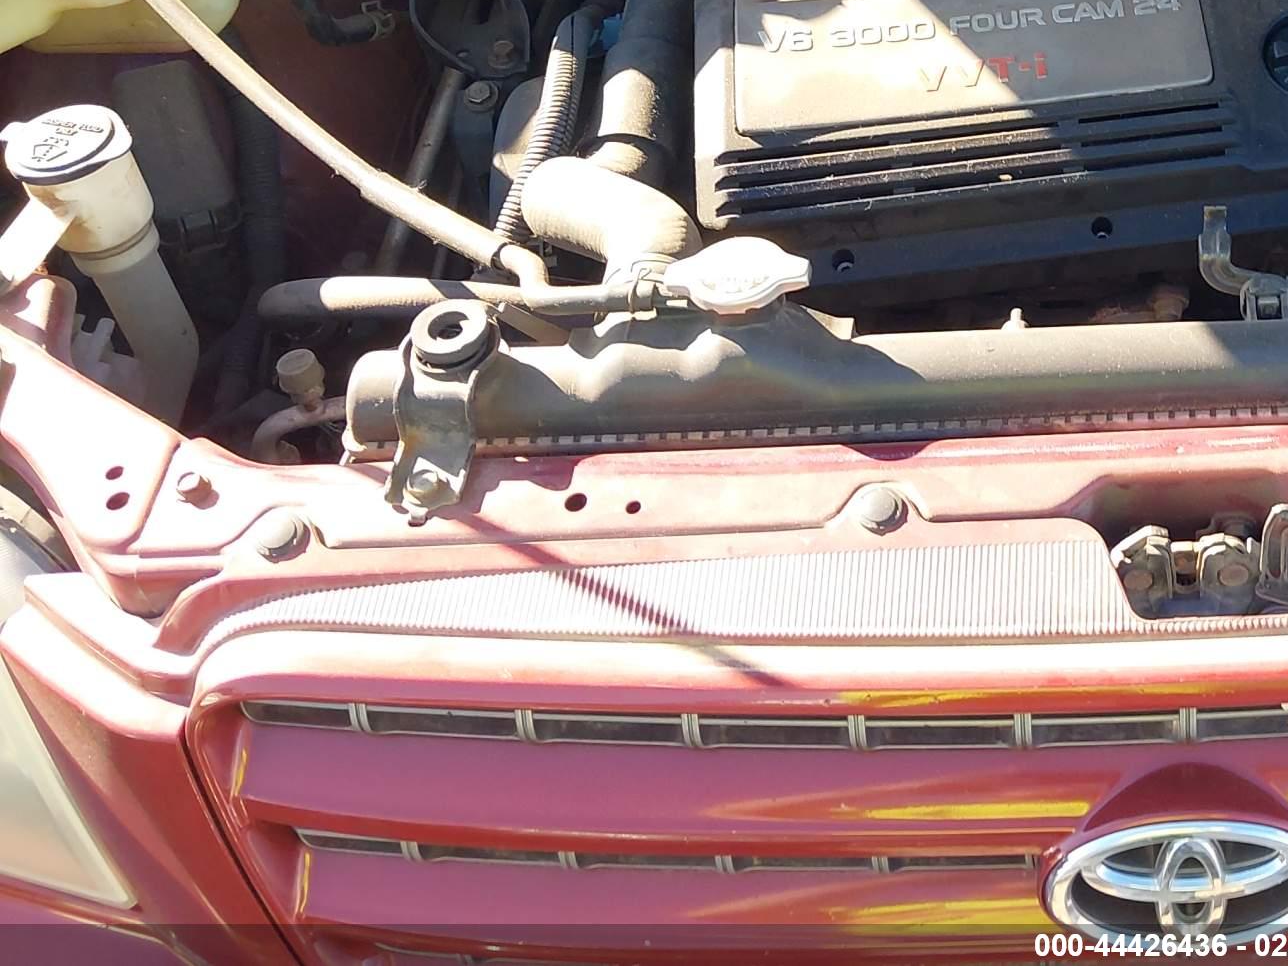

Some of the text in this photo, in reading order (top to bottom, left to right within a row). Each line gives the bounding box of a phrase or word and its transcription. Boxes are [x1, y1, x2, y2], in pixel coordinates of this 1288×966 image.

[758, 27, 813, 52] V6
[831, 19, 936, 47] 3000
[950, 9, 1046, 35] FOUR
[1051, 2, 1125, 24] CAM
[920, 51, 1049, 92] VVT-i
